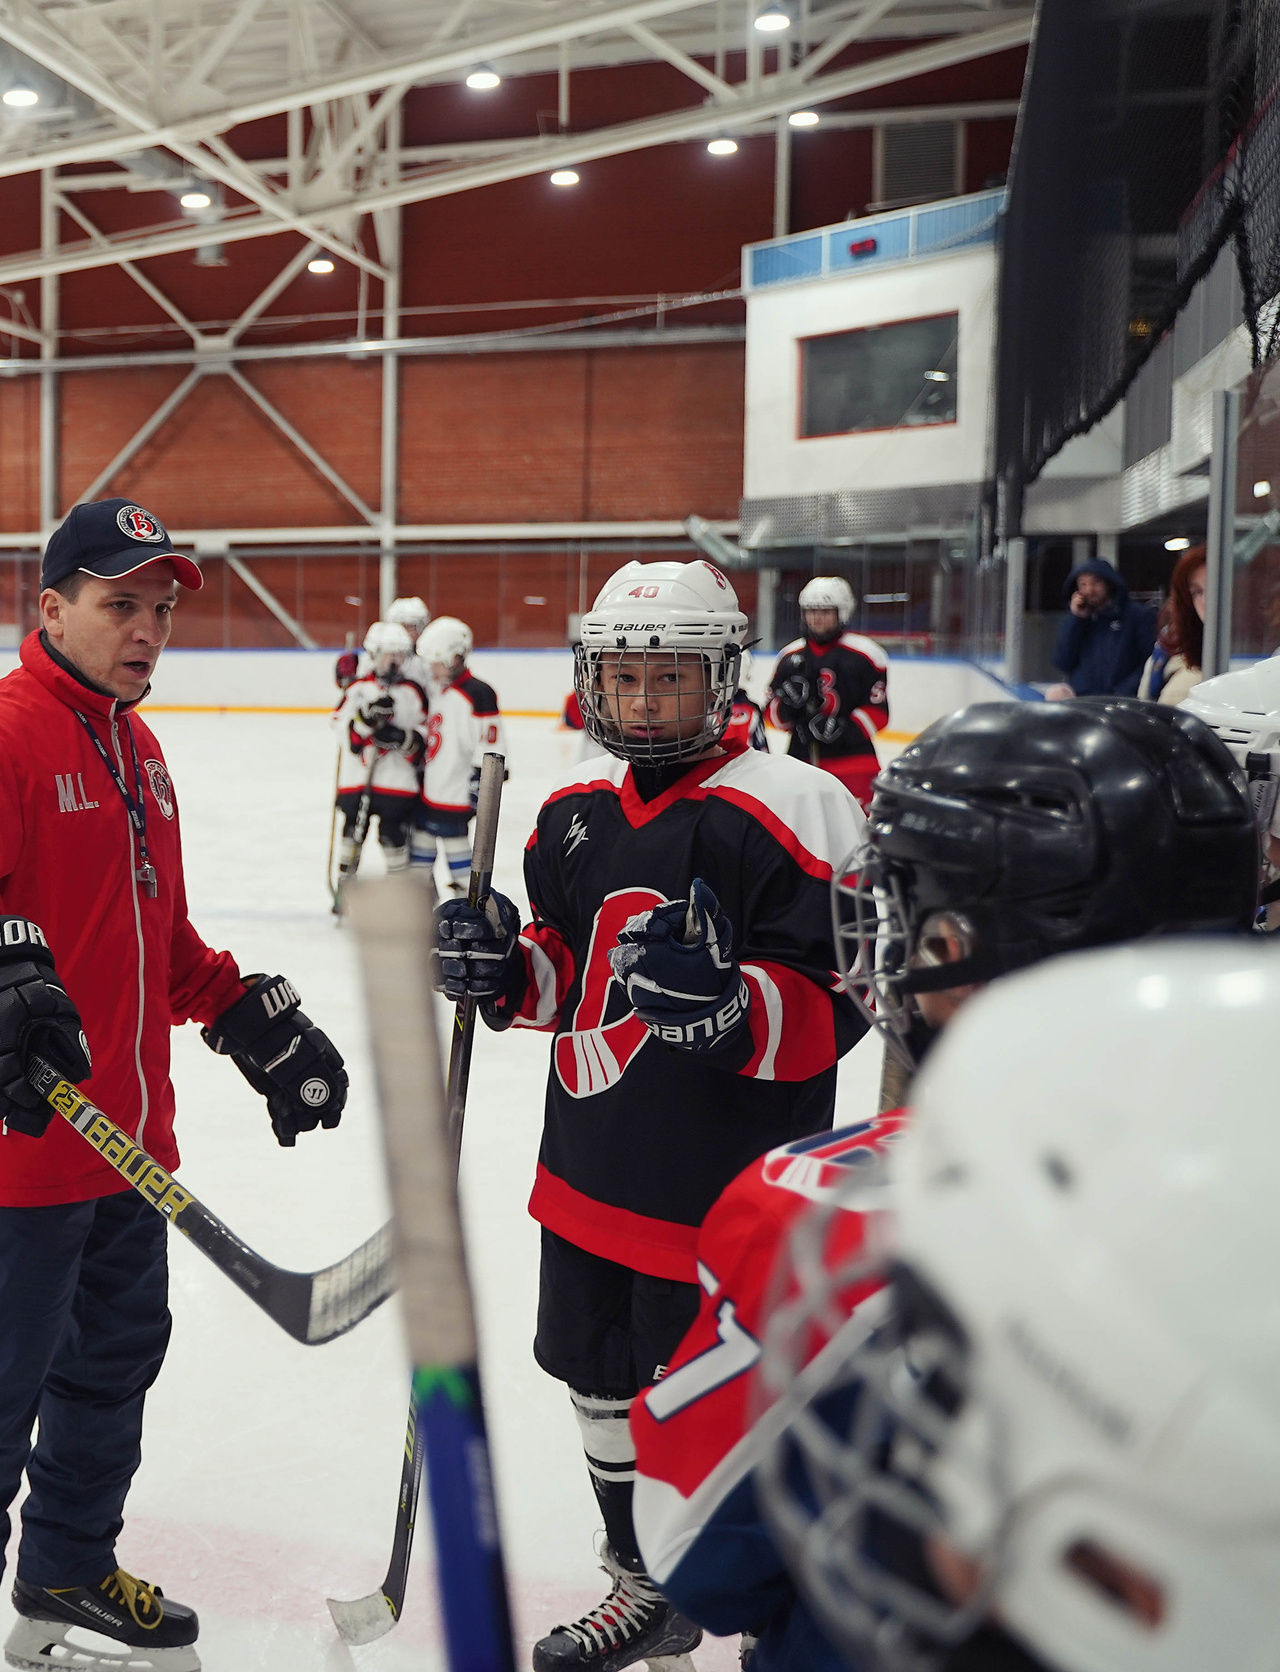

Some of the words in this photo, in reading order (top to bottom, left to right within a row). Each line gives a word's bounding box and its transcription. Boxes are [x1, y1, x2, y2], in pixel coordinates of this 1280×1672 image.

[628, 585, 660, 599] 40
[612, 623, 667, 632] BAUER
[85, 1115, 195, 1224] BAUER
[80, 1599, 123, 1628] BAUER
